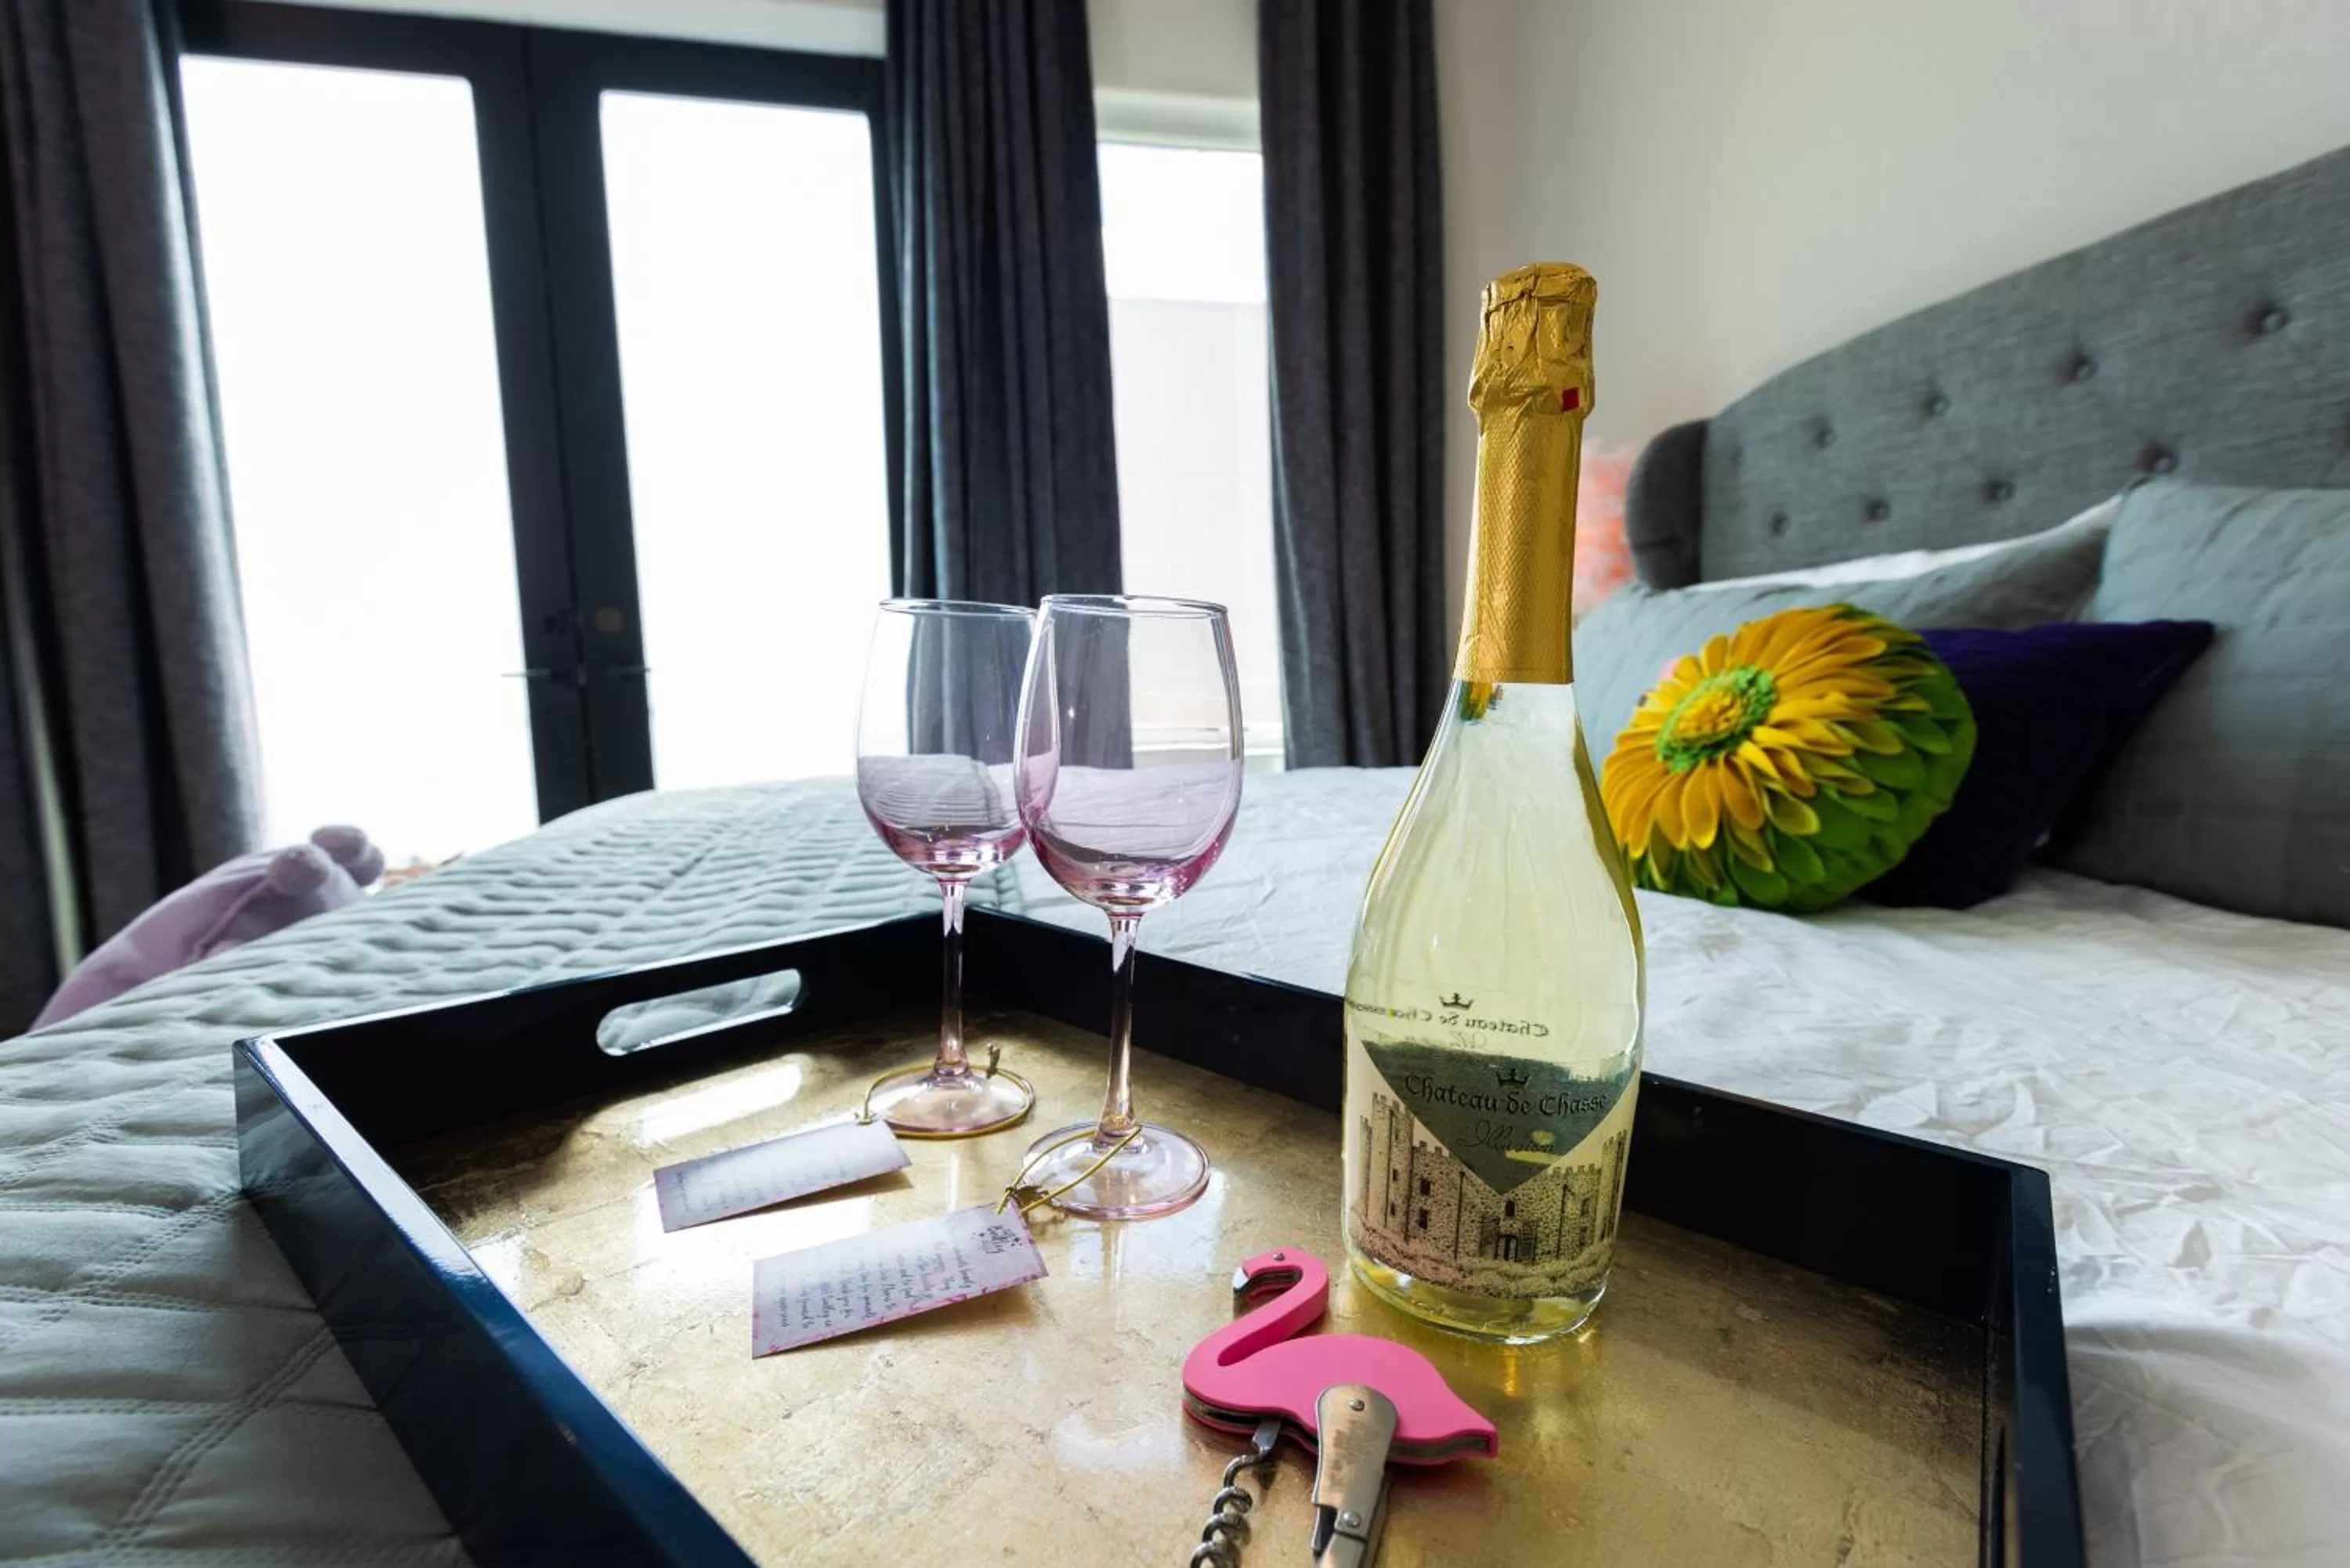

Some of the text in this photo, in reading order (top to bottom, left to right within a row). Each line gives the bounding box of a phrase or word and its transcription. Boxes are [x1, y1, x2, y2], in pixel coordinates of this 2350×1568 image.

[1405, 1075, 1608, 1120] Chateau de Chasse
